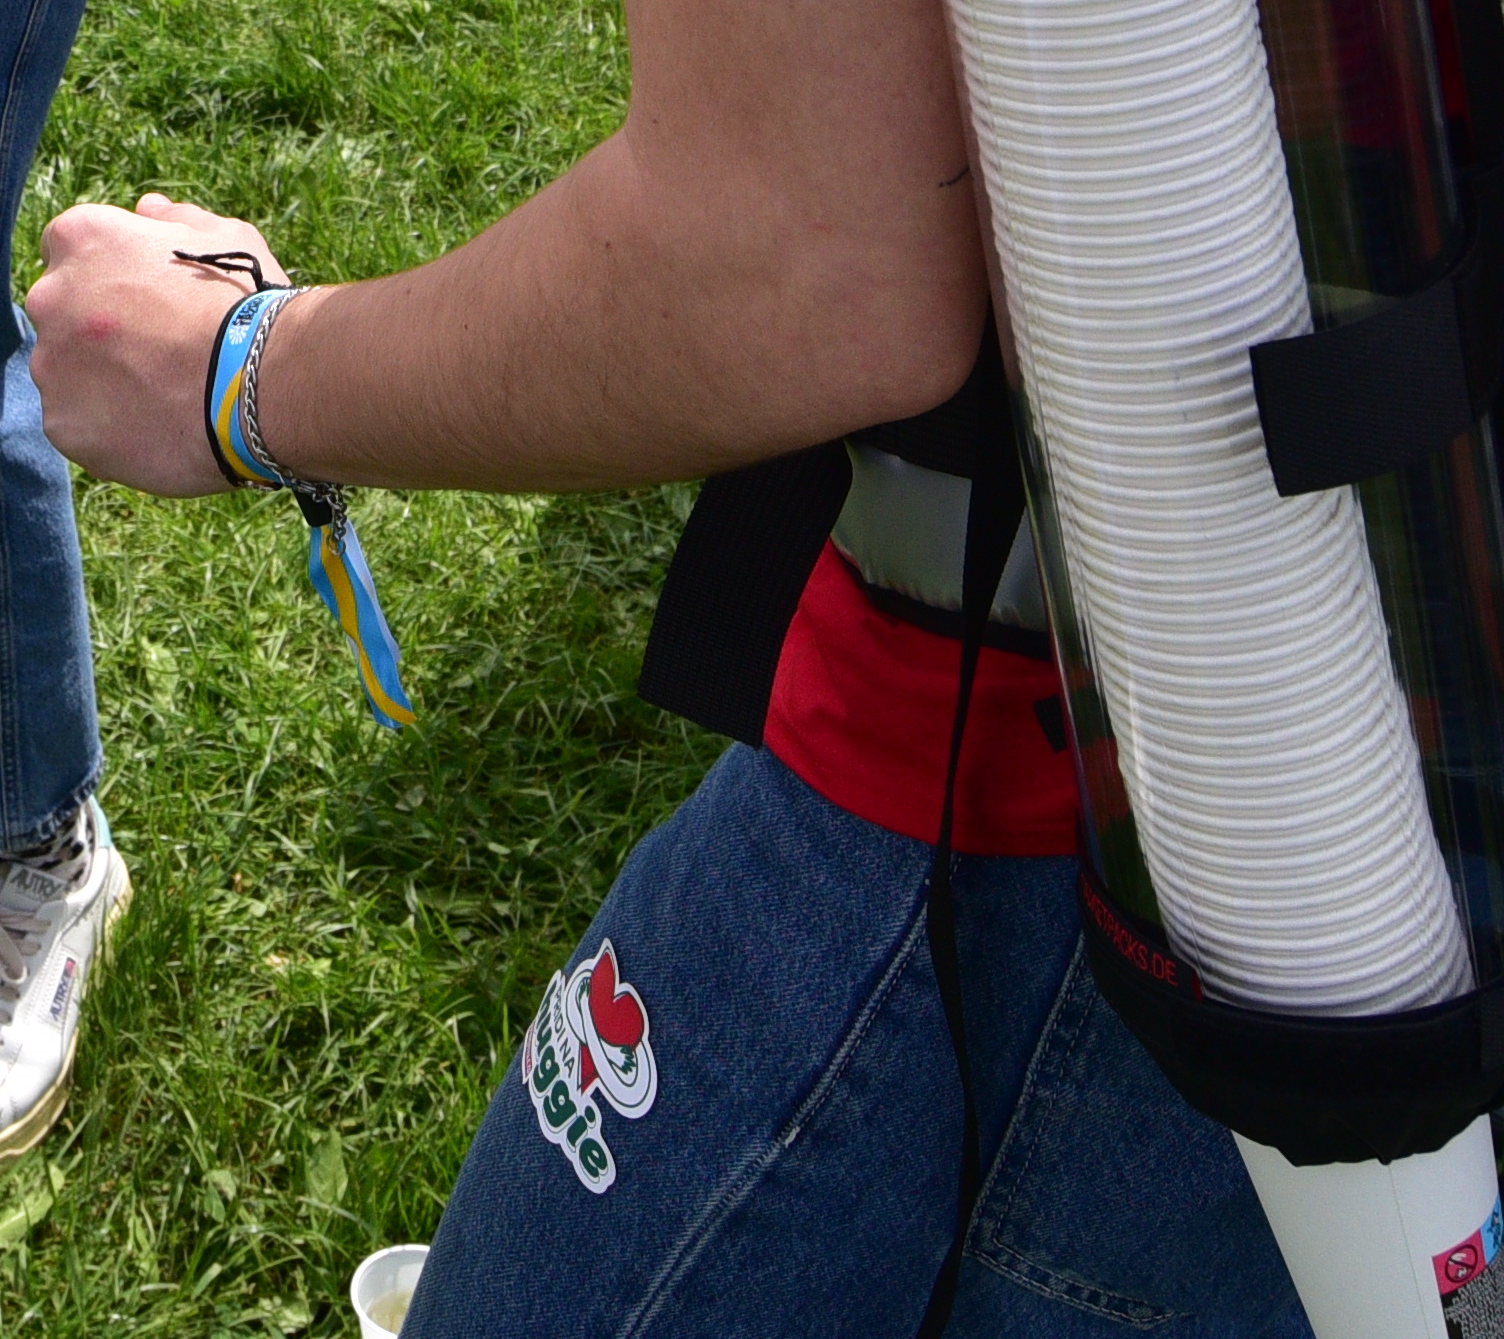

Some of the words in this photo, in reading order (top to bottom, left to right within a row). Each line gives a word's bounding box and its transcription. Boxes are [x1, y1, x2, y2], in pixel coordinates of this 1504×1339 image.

[10, 868, 63, 898] AUTRY
[48, 976, 71, 1021] AUTRY
[532, 979, 609, 1179] huggie
[558, 1036, 576, 1079] NA
